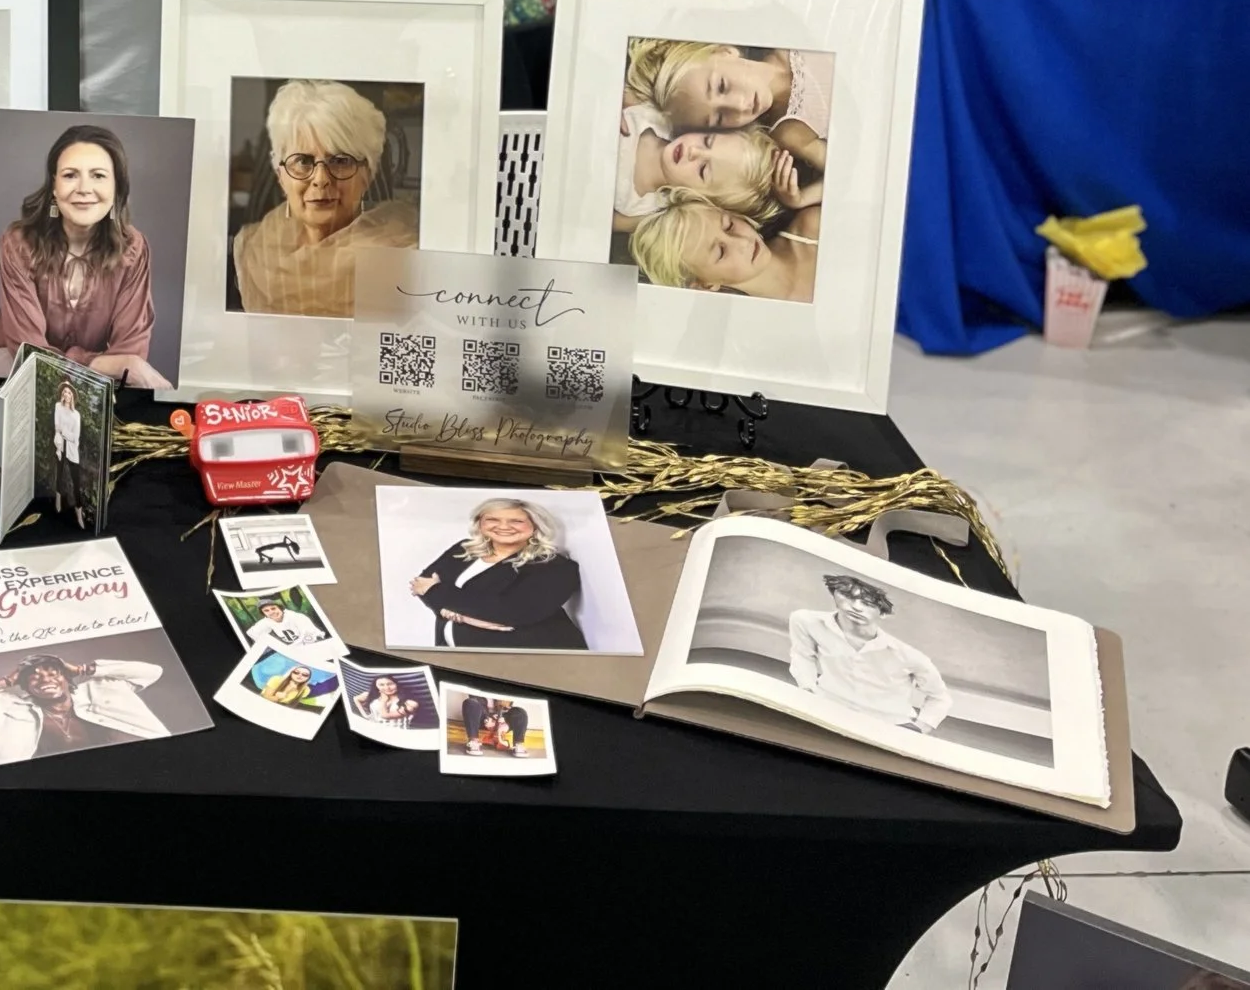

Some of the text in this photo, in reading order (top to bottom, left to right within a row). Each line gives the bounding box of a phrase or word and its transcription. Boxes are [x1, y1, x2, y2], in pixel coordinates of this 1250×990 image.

[396, 279, 586, 326] connect
[457, 314, 527, 330] WITH US
[382, 408, 594, 457] Studio Bliss Photography
[3, 565, 126, 590] EXPERIENCE
[8, 631, 31, 642] the
[32, 626, 58, 639] QR
[59, 622, 90, 635] code
[91, 619, 106, 629] to
[107, 611, 149, 626] Enter!
